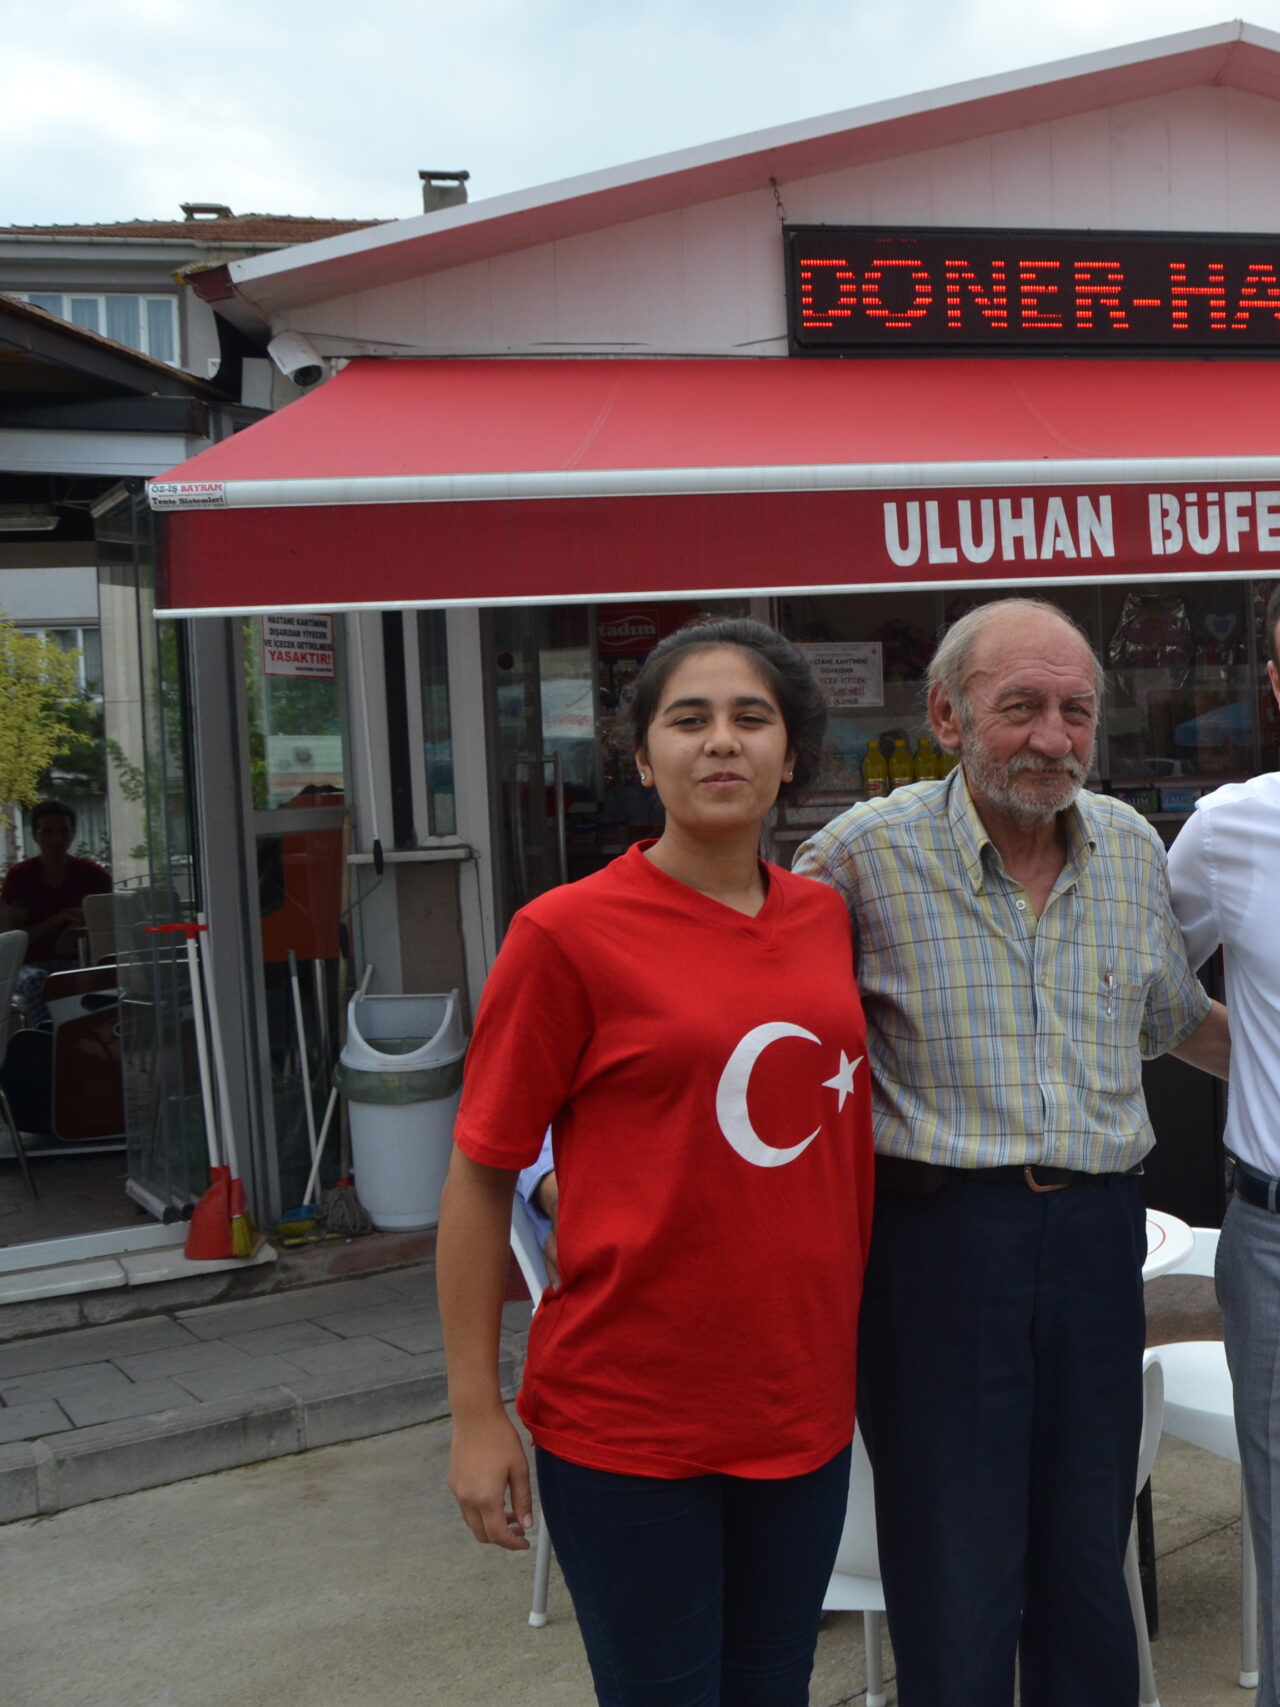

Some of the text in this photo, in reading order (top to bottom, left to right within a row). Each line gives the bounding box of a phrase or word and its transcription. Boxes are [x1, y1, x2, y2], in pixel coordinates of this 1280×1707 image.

[180, 484, 222, 492] BAYRAM
[884, 494, 1115, 567] ULUHAN
[268, 650, 331, 665] YASAKTIR!
